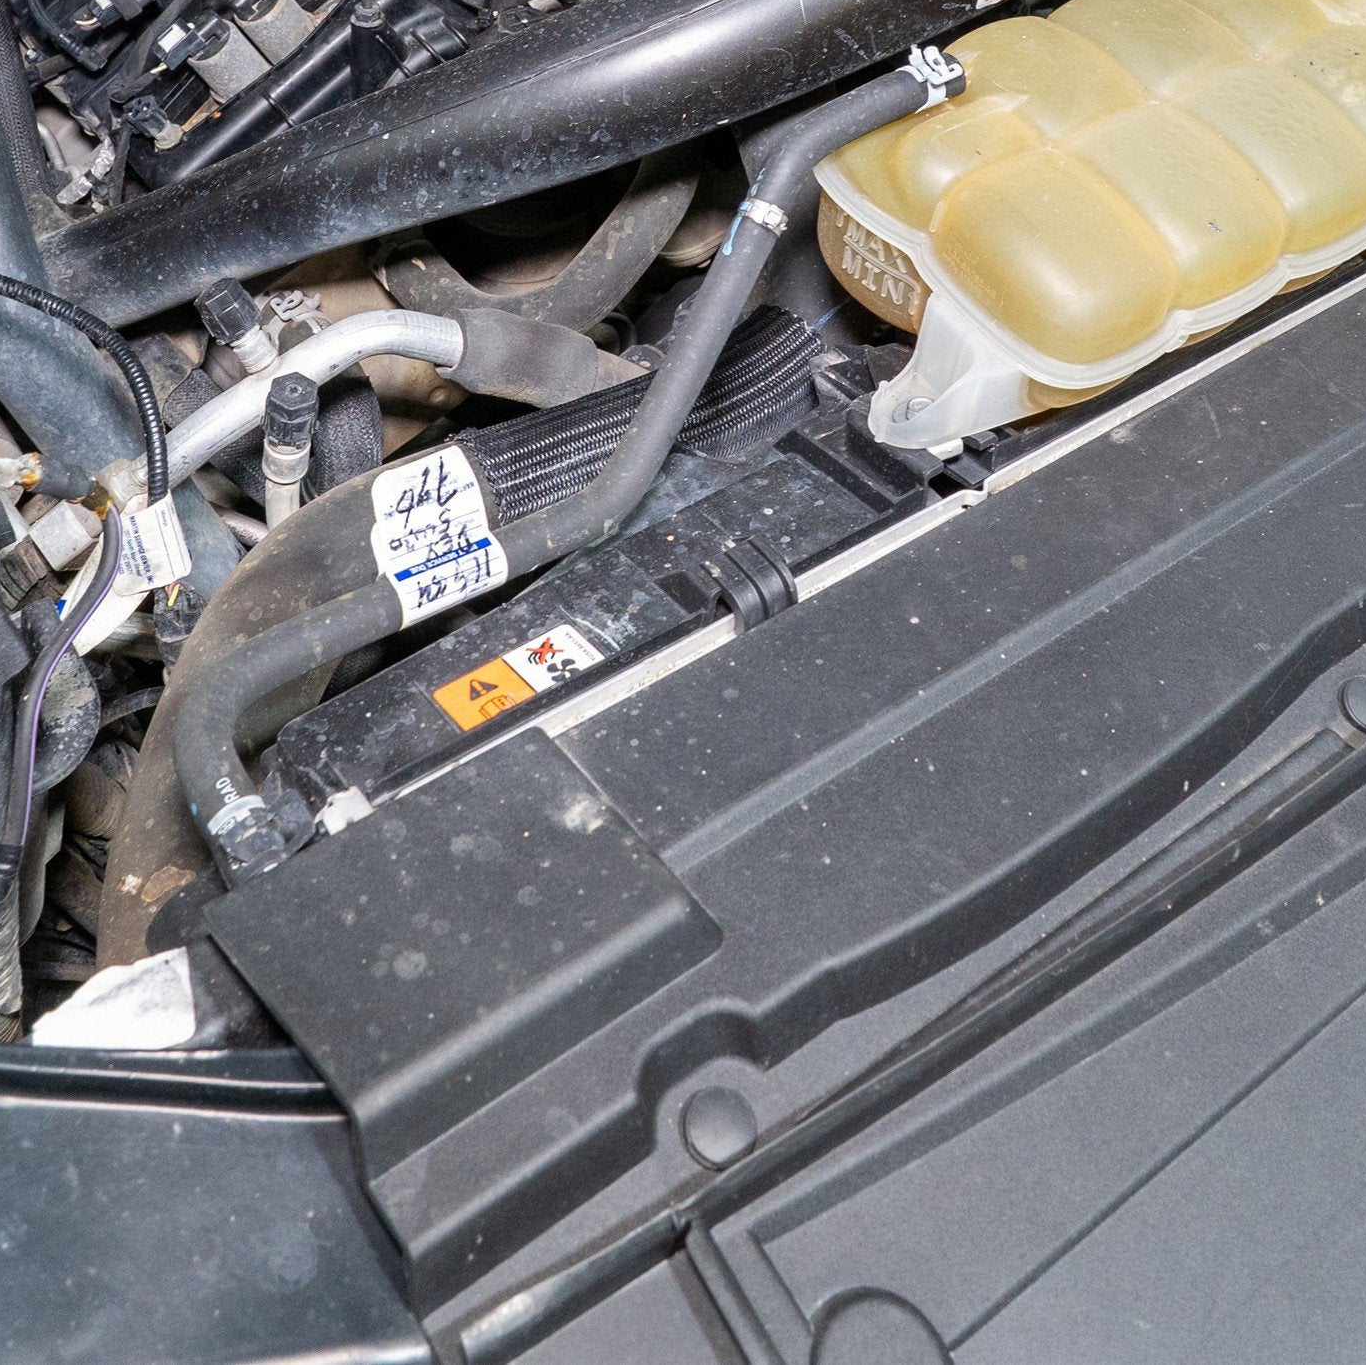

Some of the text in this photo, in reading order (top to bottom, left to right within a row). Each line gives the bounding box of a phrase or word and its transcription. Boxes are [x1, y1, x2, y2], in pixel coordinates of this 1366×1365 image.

[843, 217, 912, 274] MAX
[839, 244, 911, 307] MIN
[128, 515, 139, 535] MARTIN
[133, 533, 145, 555] SERVICE
[138, 554, 151, 575] CENTER,
[408, 562, 425, 575] DUE
[424, 550, 456, 569] SERVICE
[215, 776, 240, 804] RAD
